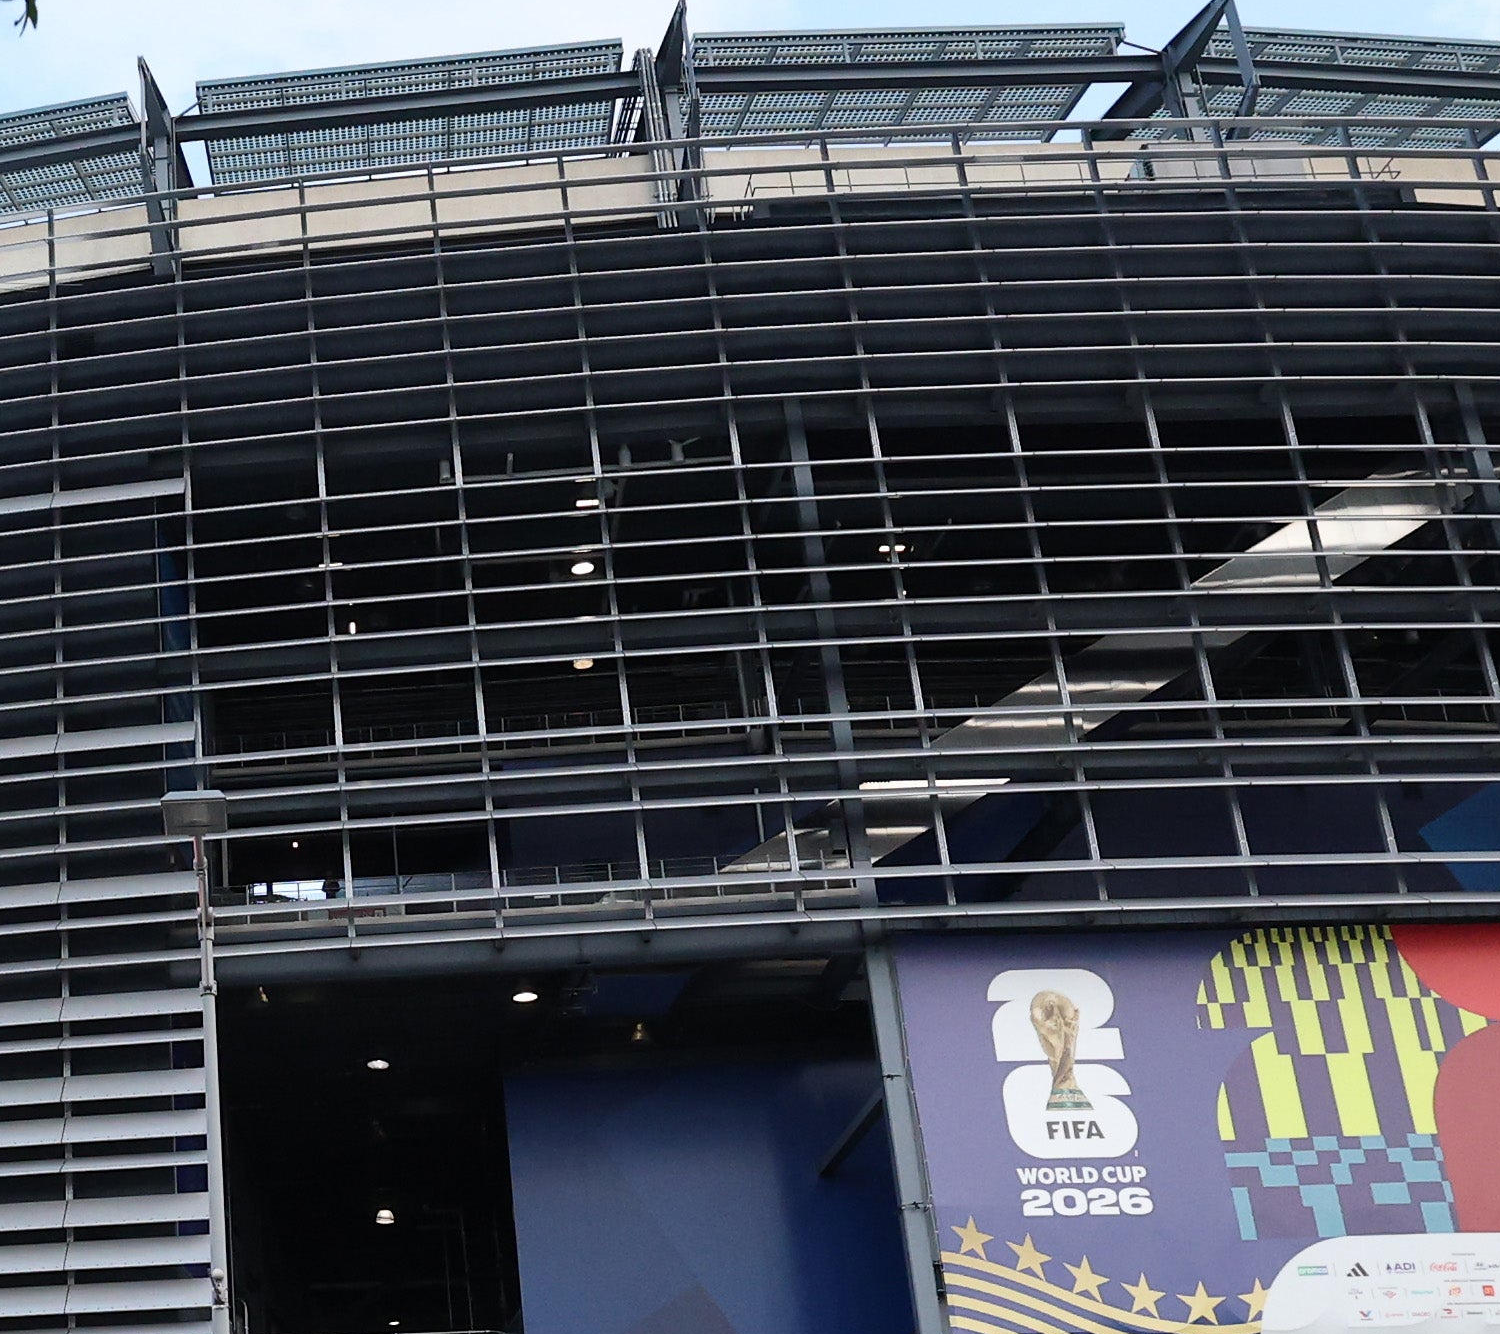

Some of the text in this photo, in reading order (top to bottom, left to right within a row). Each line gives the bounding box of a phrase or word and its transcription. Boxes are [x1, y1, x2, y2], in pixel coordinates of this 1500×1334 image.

[1045, 1119, 1105, 1141] FIFA
[1016, 1164, 1148, 1186] WORLD CUP
[1021, 1187, 1154, 1216] 2026
[1395, 1263, 1416, 1271] ADI
